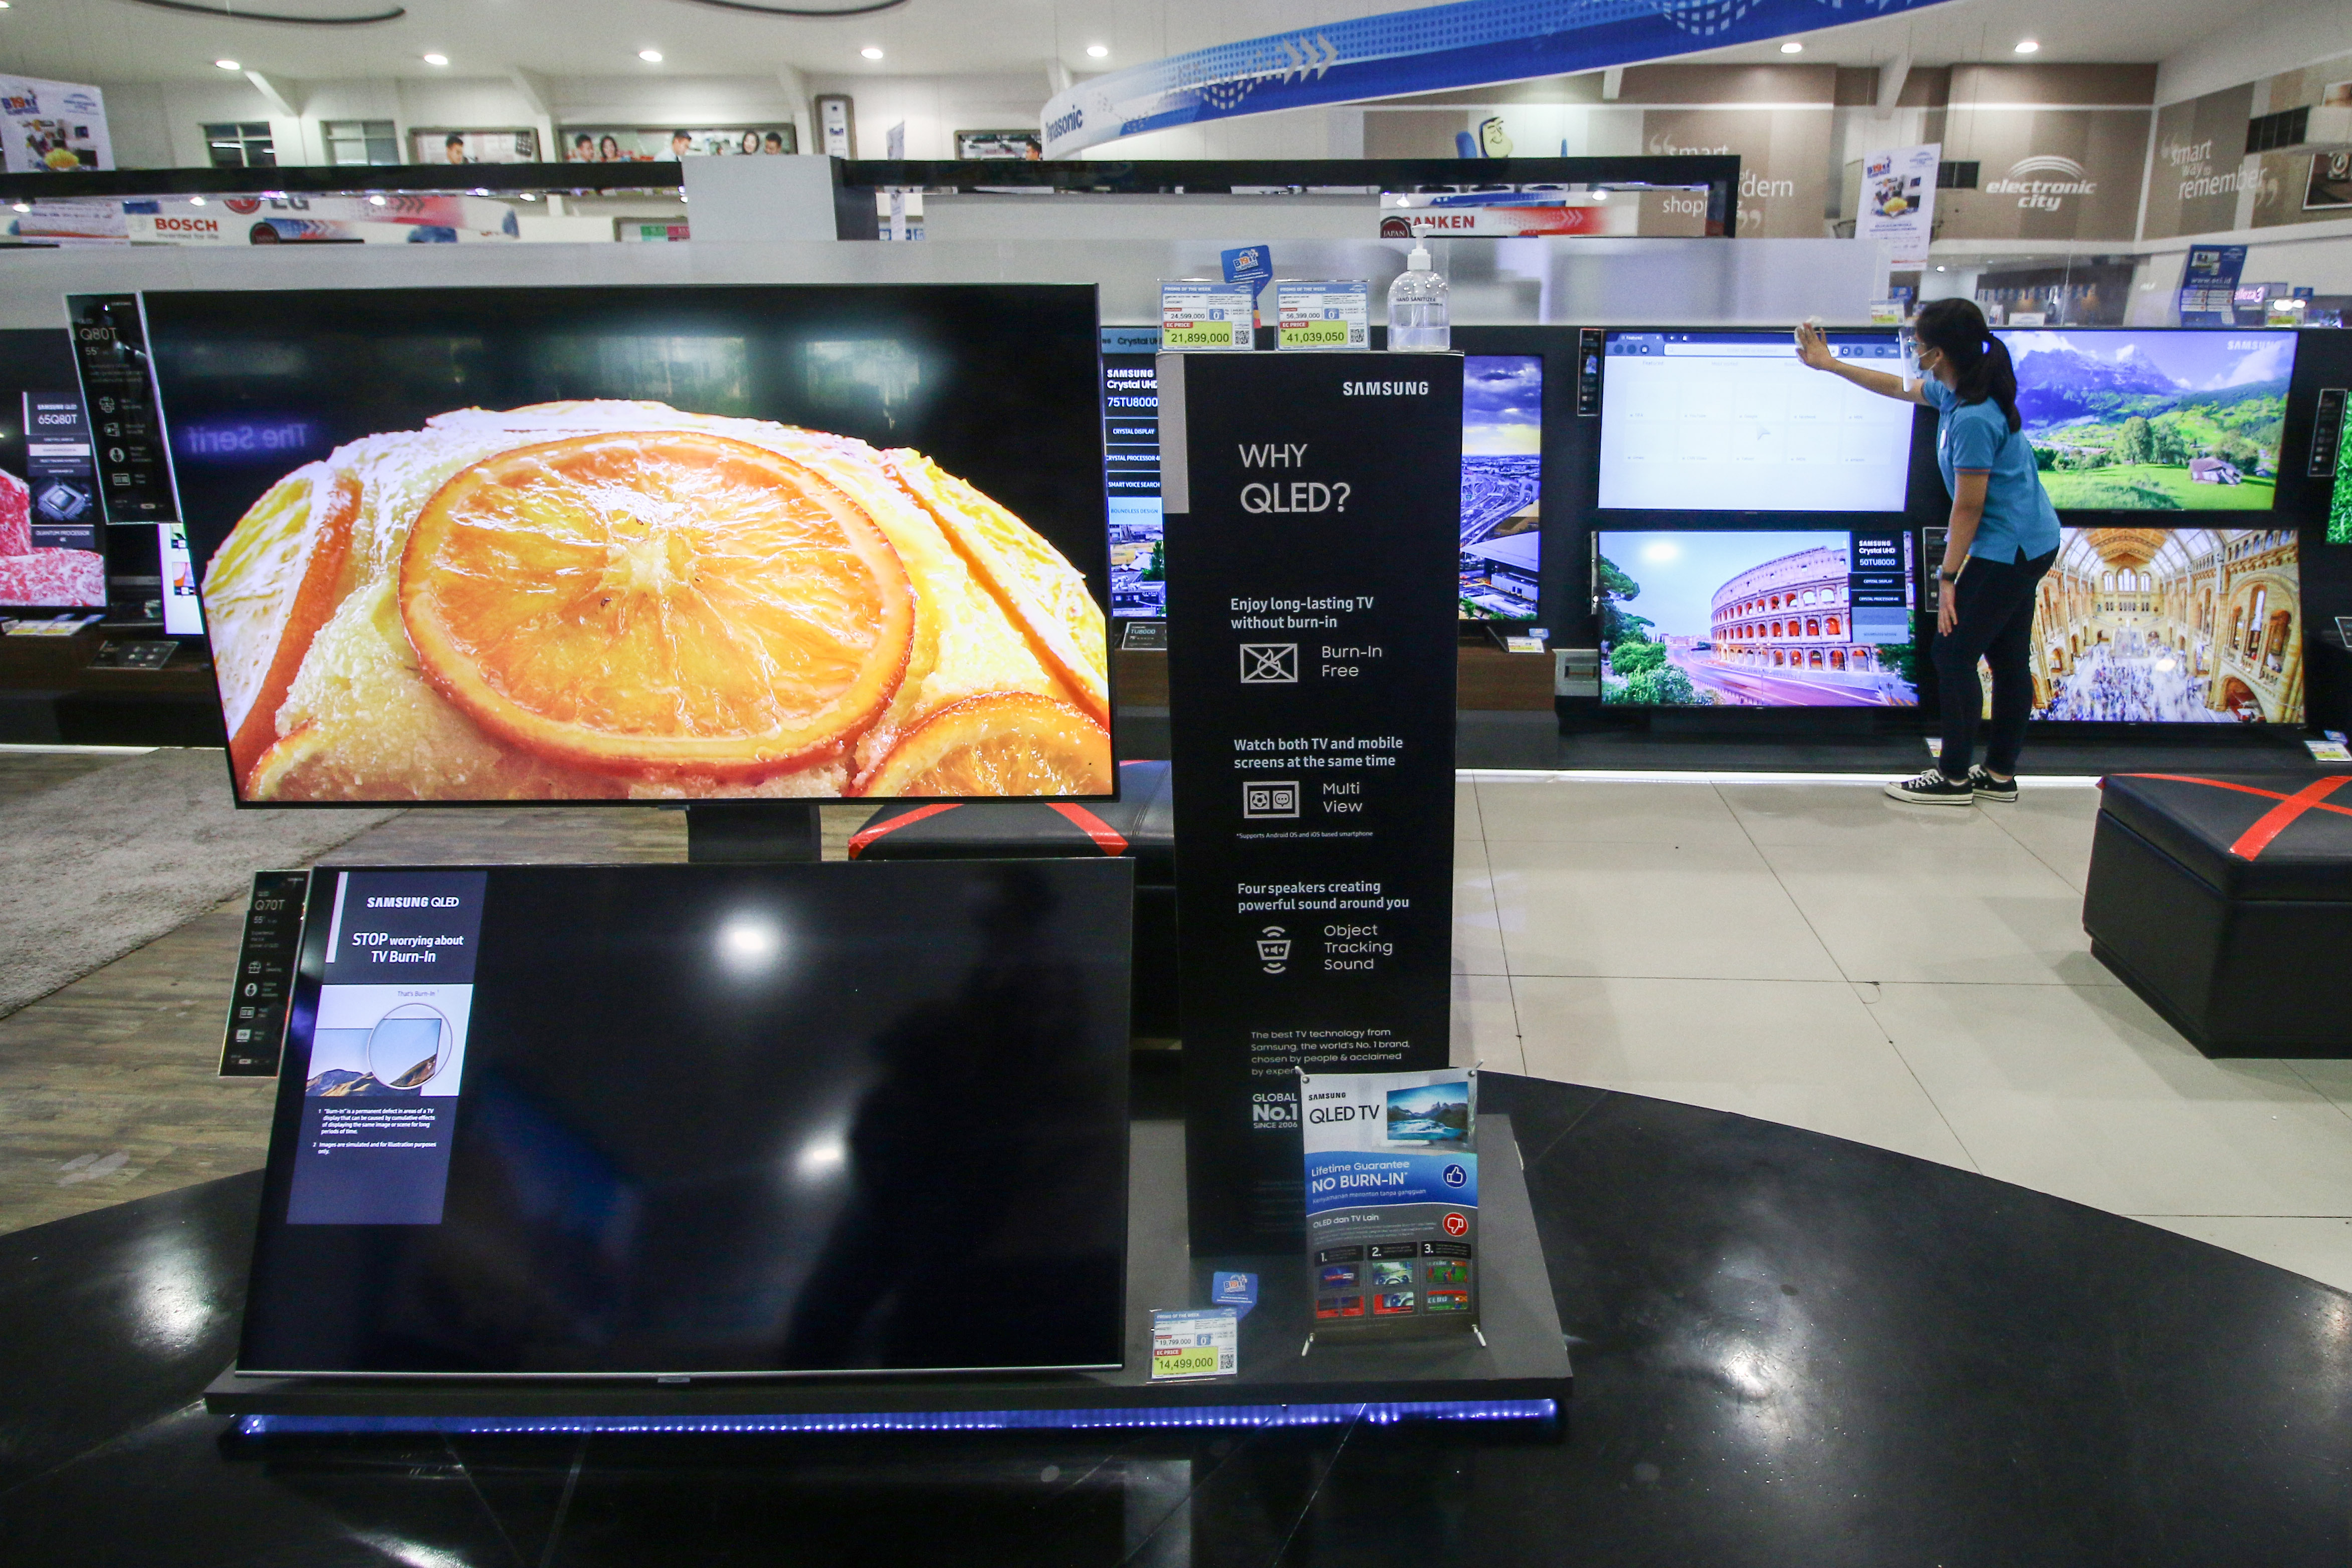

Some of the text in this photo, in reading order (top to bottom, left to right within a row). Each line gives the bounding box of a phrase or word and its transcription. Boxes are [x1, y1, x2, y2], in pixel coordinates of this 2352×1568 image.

[1738, 173, 1793, 197] dern
[1986, 178, 2097, 194] electronic
[2178, 166, 2268, 199] remember
[2018, 193, 2062, 211] city
[154, 217, 218, 232] BOSCH
[80, 327, 117, 341] Q80T
[1171, 333, 1229, 343] 21,899,000
[1287, 332, 1344, 343] 41,039,050
[1118, 337, 1148, 347] Crystal
[2227, 339, 2282, 350] SAMSUNG
[1107, 369, 1154, 378] SAMSUNG
[1107, 379, 1140, 391] Crystal
[1343, 381, 1428, 395] SAMSUNG
[1107, 397, 1159, 407] 75TU8000
[38, 414, 78, 424] 65Q80T
[1239, 444, 1308, 468] WHY
[1240, 482, 1351, 514] QLED?
[1231, 596, 1374, 613] Enjoy long-lasting TV
[1231, 615, 1338, 629] without burn-in
[1322, 645, 1382, 658] Burn-In
[1322, 664, 1359, 677] Free
[1234, 737, 1403, 751] Watch both TV and mobile
[1234, 755, 1396, 769] screens at the same time
[1323, 782, 1360, 795] Multi
[1323, 800, 1363, 812] View
[1238, 880, 1381, 896] Four speakers creating
[367, 897, 460, 908] SAMSUNG QLED
[1238, 897, 1409, 913] powerful sound around you
[1324, 924, 1378, 939] Object
[352, 933, 464, 948] STOP worrying about
[1324, 941, 1393, 956] Tracking
[371, 950, 437, 963] TV Burn-In
[1324, 958, 1374, 970] Sound
[1309, 1030, 1365, 1039] technology
[1251, 1043, 1299, 1052] Samsung,
[1290, 1055, 1302, 1064] by
[1304, 1054, 1338, 1063] people
[1350, 1053, 1402, 1061] acclaimed
[1252, 1067, 1263, 1076] by
[1252, 1093, 1298, 1102] GLOBAL
[1309, 1091, 1347, 1100] SAMSUNG
[1253, 1103, 1298, 1121] No.1
[1309, 1105, 1380, 1124] QLED TV
[1311, 1160, 1410, 1177] Lifetime Guarantee
[1312, 1177, 1335, 1194] NO
[1313, 1218, 1332, 1228] OLED
[1334, 1216, 1349, 1224] dan
[1321, 1252, 1328, 1262] 1.
[1372, 1247, 1382, 1257] 2.
[1424, 1243, 1434, 1253] 3.
[1159, 1358, 1213, 1370] 14,499,000
